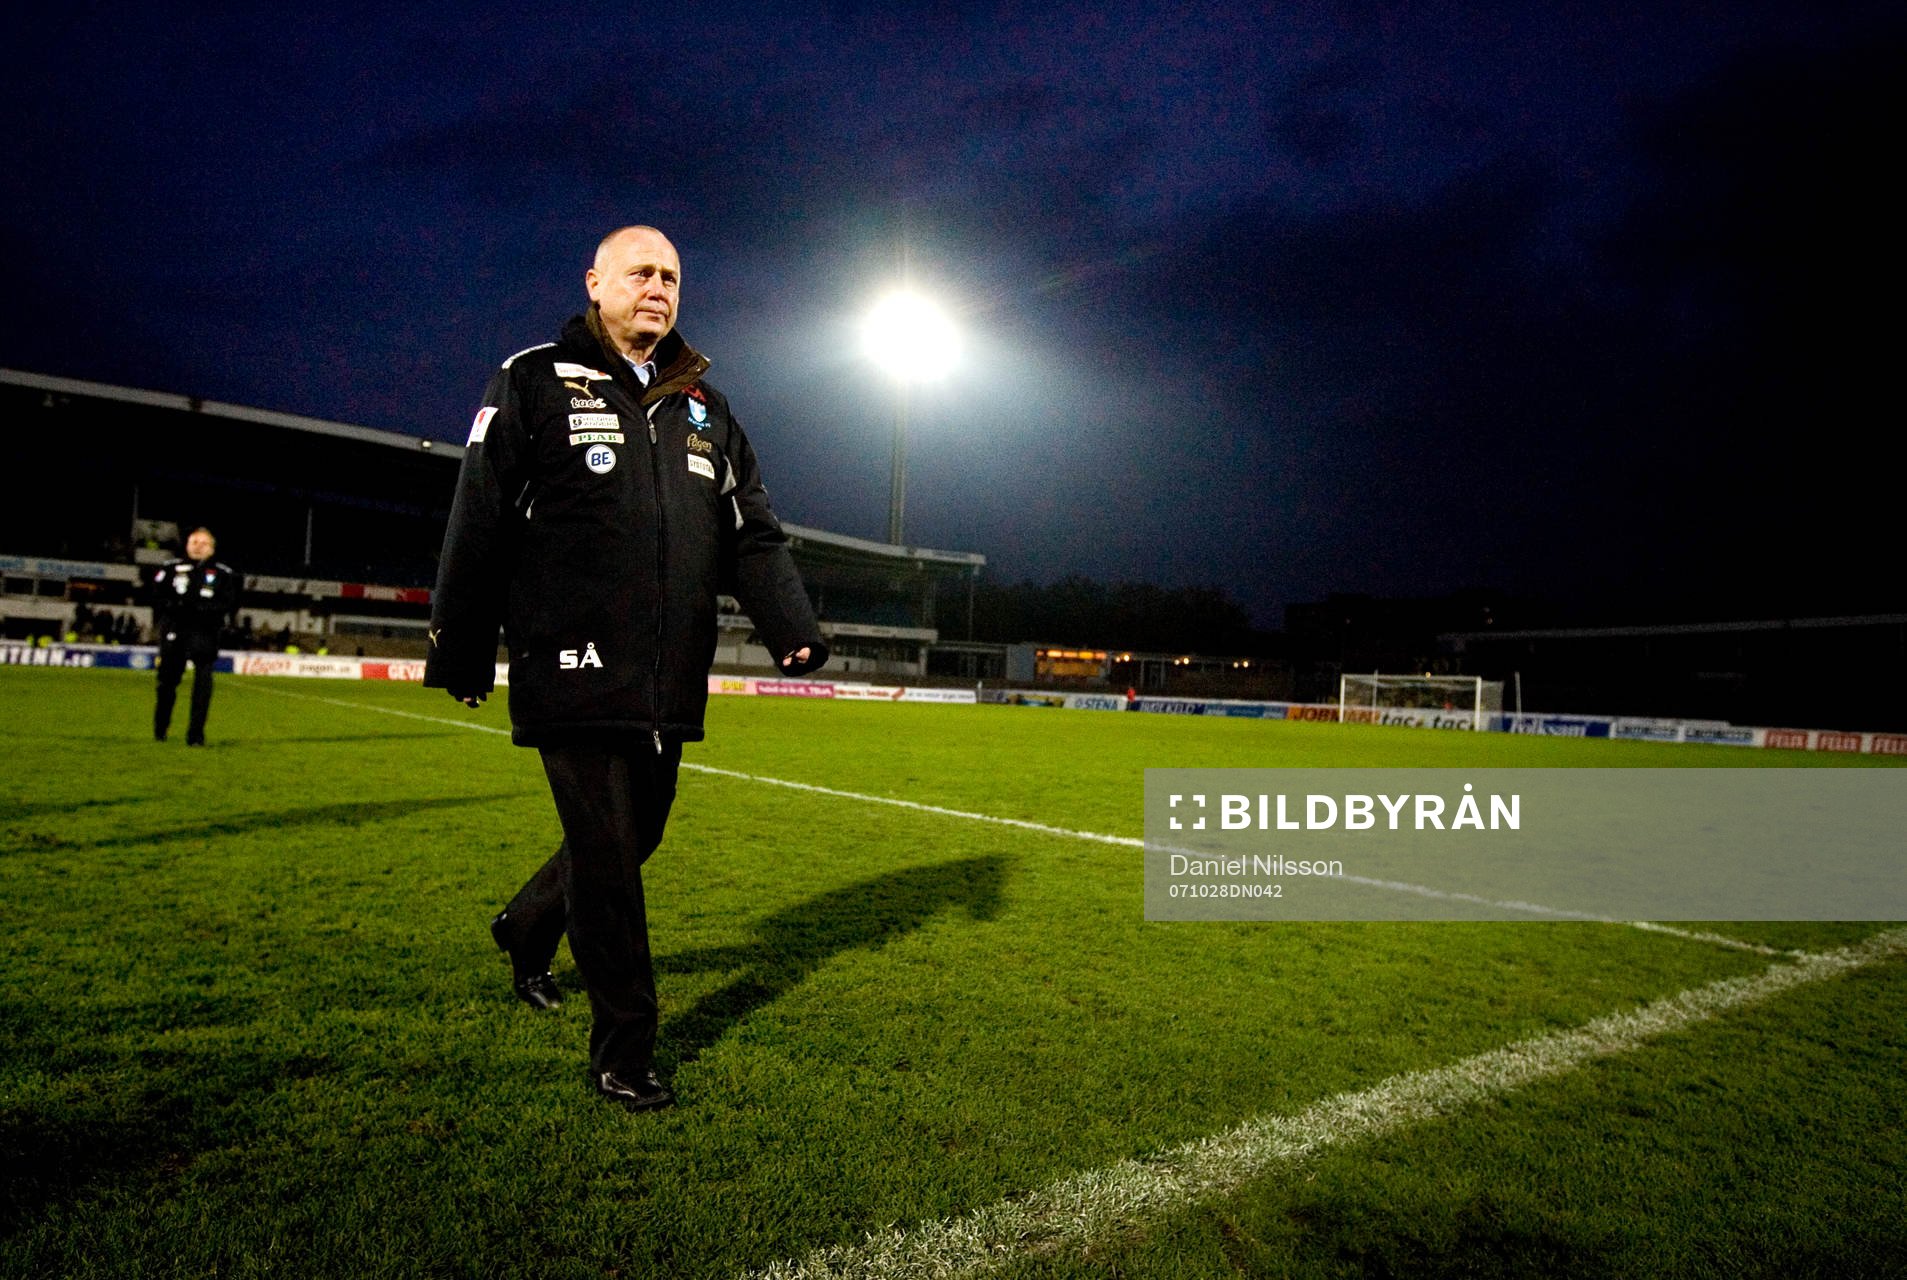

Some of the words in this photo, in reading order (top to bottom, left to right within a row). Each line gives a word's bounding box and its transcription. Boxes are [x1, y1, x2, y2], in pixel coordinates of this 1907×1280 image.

[591, 452, 611, 466] BE
[560, 641, 603, 670] SÅ
[1819, 734, 1858, 751] FELIX
